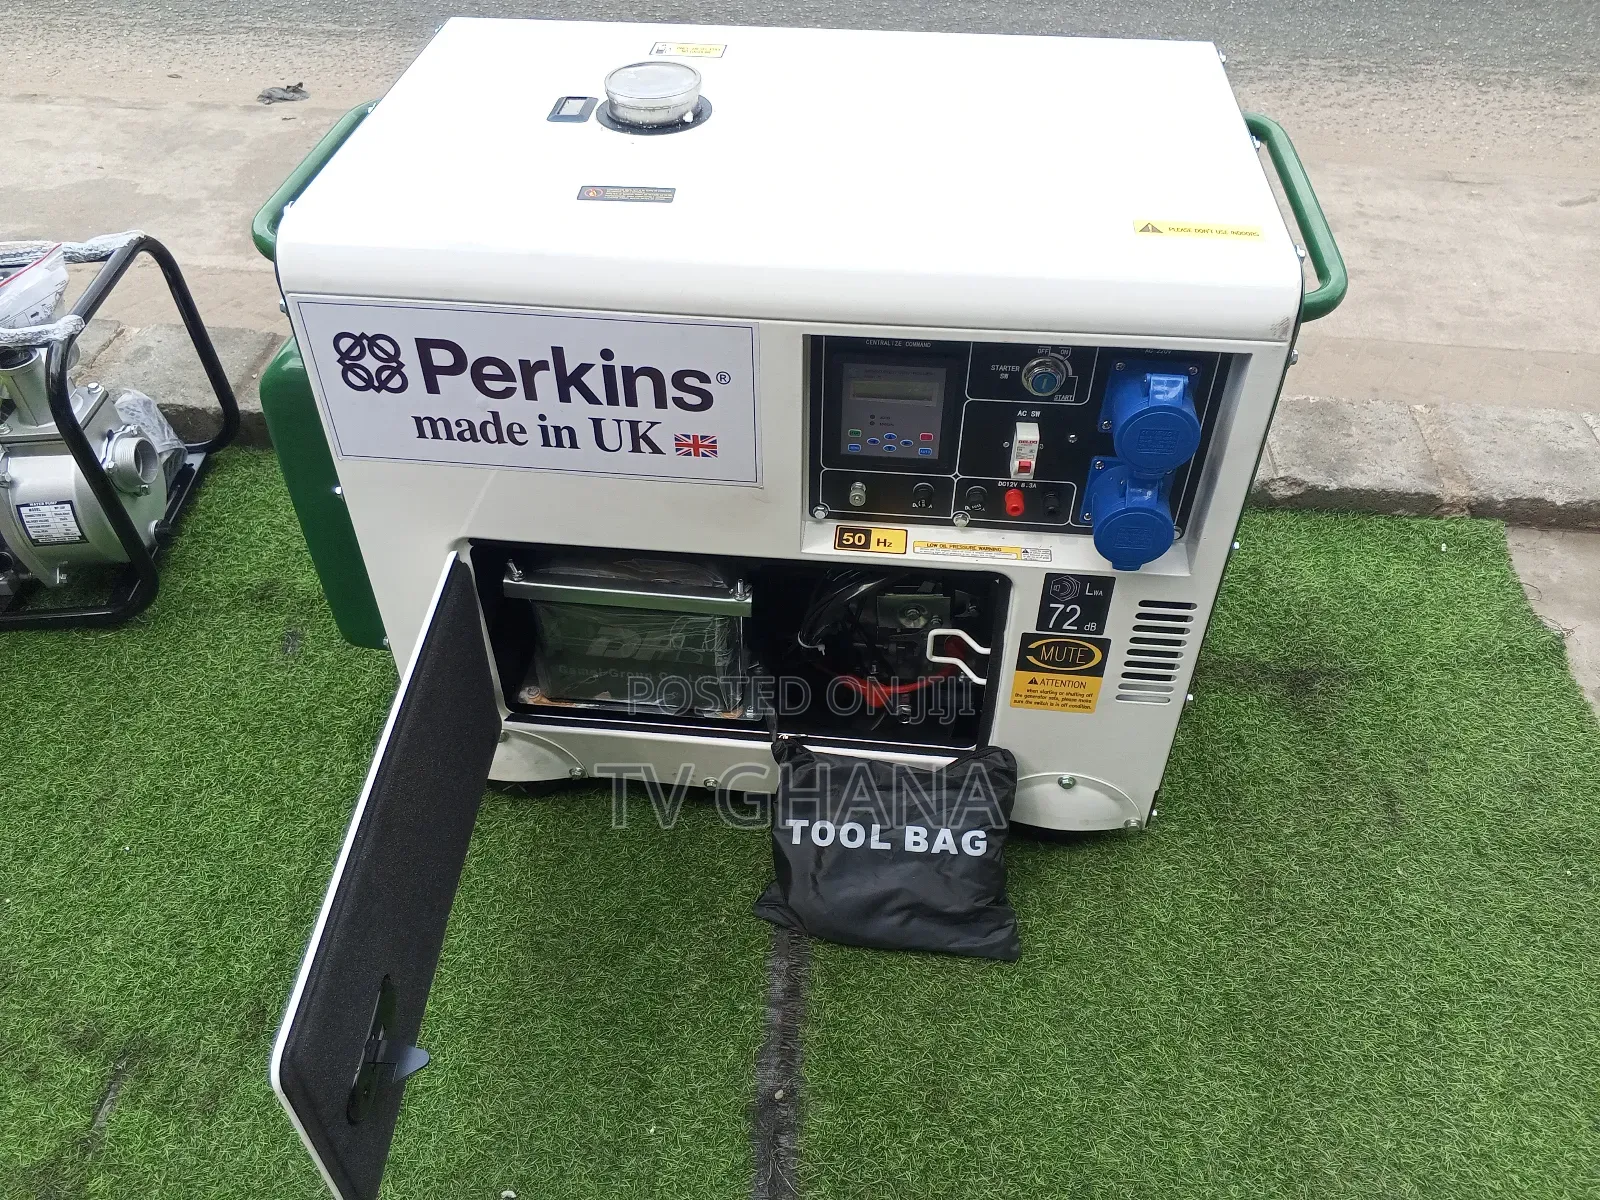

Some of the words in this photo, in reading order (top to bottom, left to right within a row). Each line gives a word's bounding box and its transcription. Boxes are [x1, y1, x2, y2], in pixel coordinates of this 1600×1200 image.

[865, 339, 902, 347] CENTRALIZE
[991, 364, 1020, 372] STARTER
[411, 411, 529, 447] made
[538, 413, 581, 450] in
[588, 417, 667, 455] UK
[842, 532, 866, 545] 50
[1048, 603, 1081, 630] 72
[1084, 622, 1097, 632] dB
[1040, 645, 1089, 664] MUTE
[1039, 678, 1087, 689] ATTENTION
[786, 819, 891, 850] TOOL
[904, 825, 988, 857] BAG
